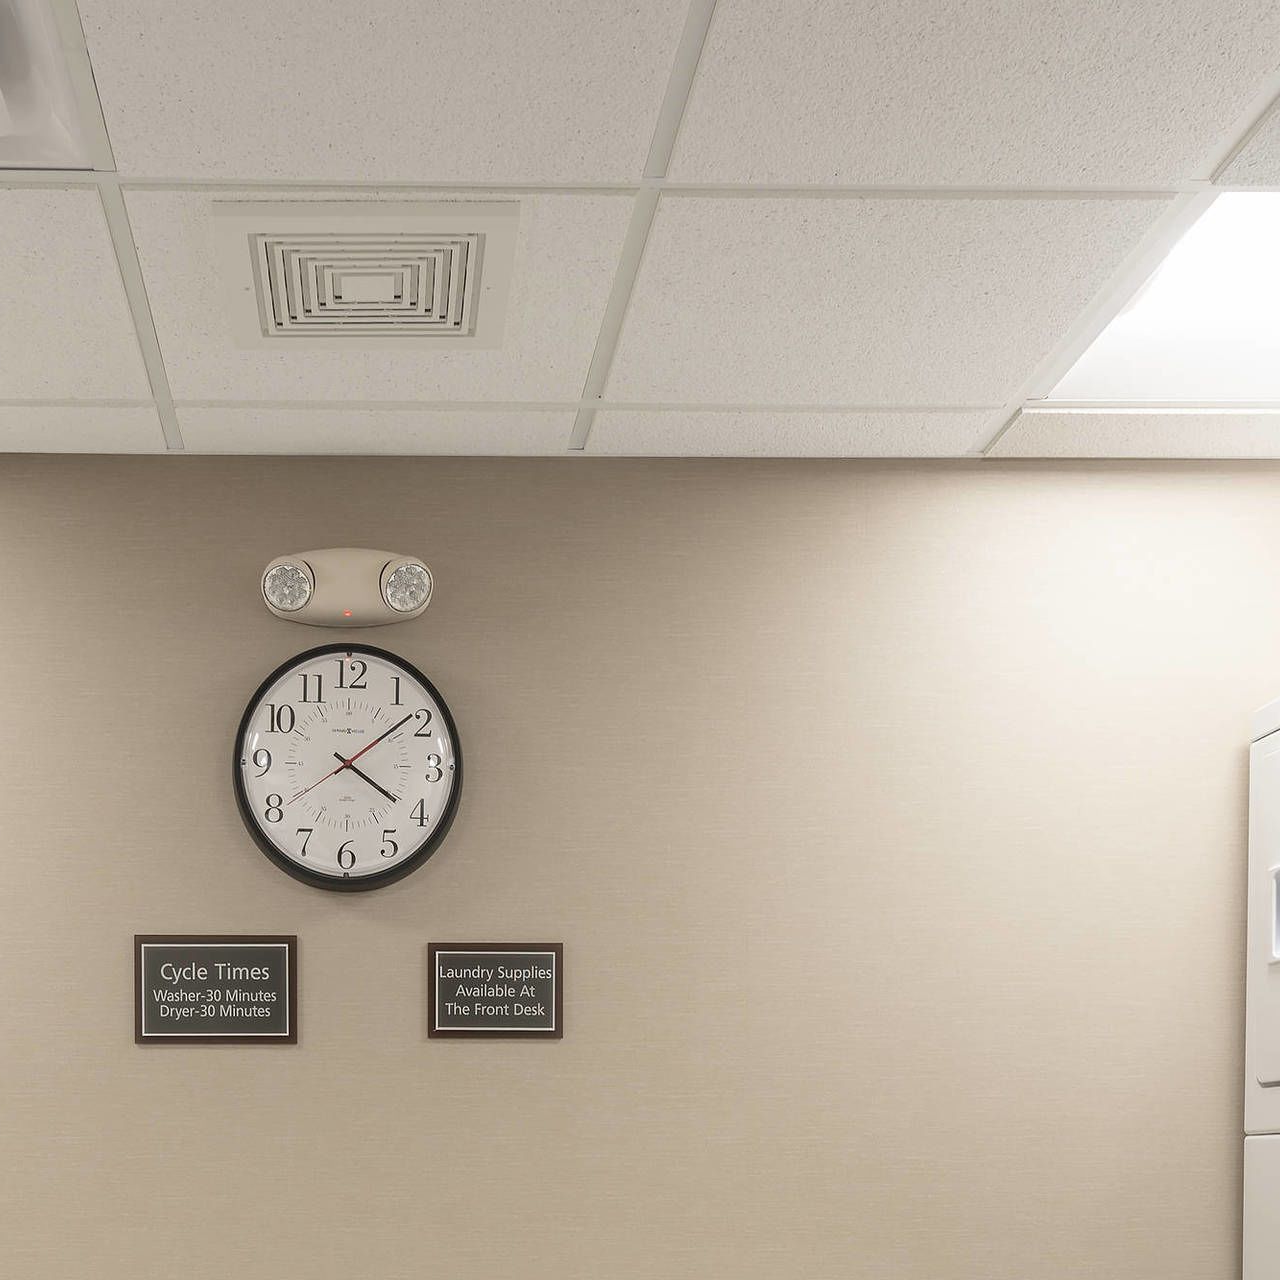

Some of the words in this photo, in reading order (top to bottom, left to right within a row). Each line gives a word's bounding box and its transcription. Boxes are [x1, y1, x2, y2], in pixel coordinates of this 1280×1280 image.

[334, 660, 367, 689] 12
[298, 674, 327, 704] 11
[390, 677, 404, 706] 1
[265, 704, 295, 734] 10
[414, 708, 433, 737] 2
[253, 749, 272, 778] 9
[425, 754, 443, 782] 3
[265, 794, 284, 823] 8
[410, 799, 429, 827] 4
[296, 829, 313, 857] 7
[338, 840, 356, 870] 6
[381, 829, 398, 858] 5
[161, 962, 208, 985] Cycle
[214, 963, 270, 980] Times
[440, 966, 494, 982] Laundry
[498, 966, 552, 981] Supplies
[153, 989, 222, 1002] Washer-30
[226, 989, 277, 1002] Minutes
[456, 984, 515, 997] Available
[520, 985, 536, 997] At
[160, 1005, 216, 1020] Dryer-30
[220, 1005, 271, 1017] Minutes
[445, 1002, 470, 1015] The
[474, 1003, 509, 1016] Front
[514, 1002, 545, 1016] Desk
